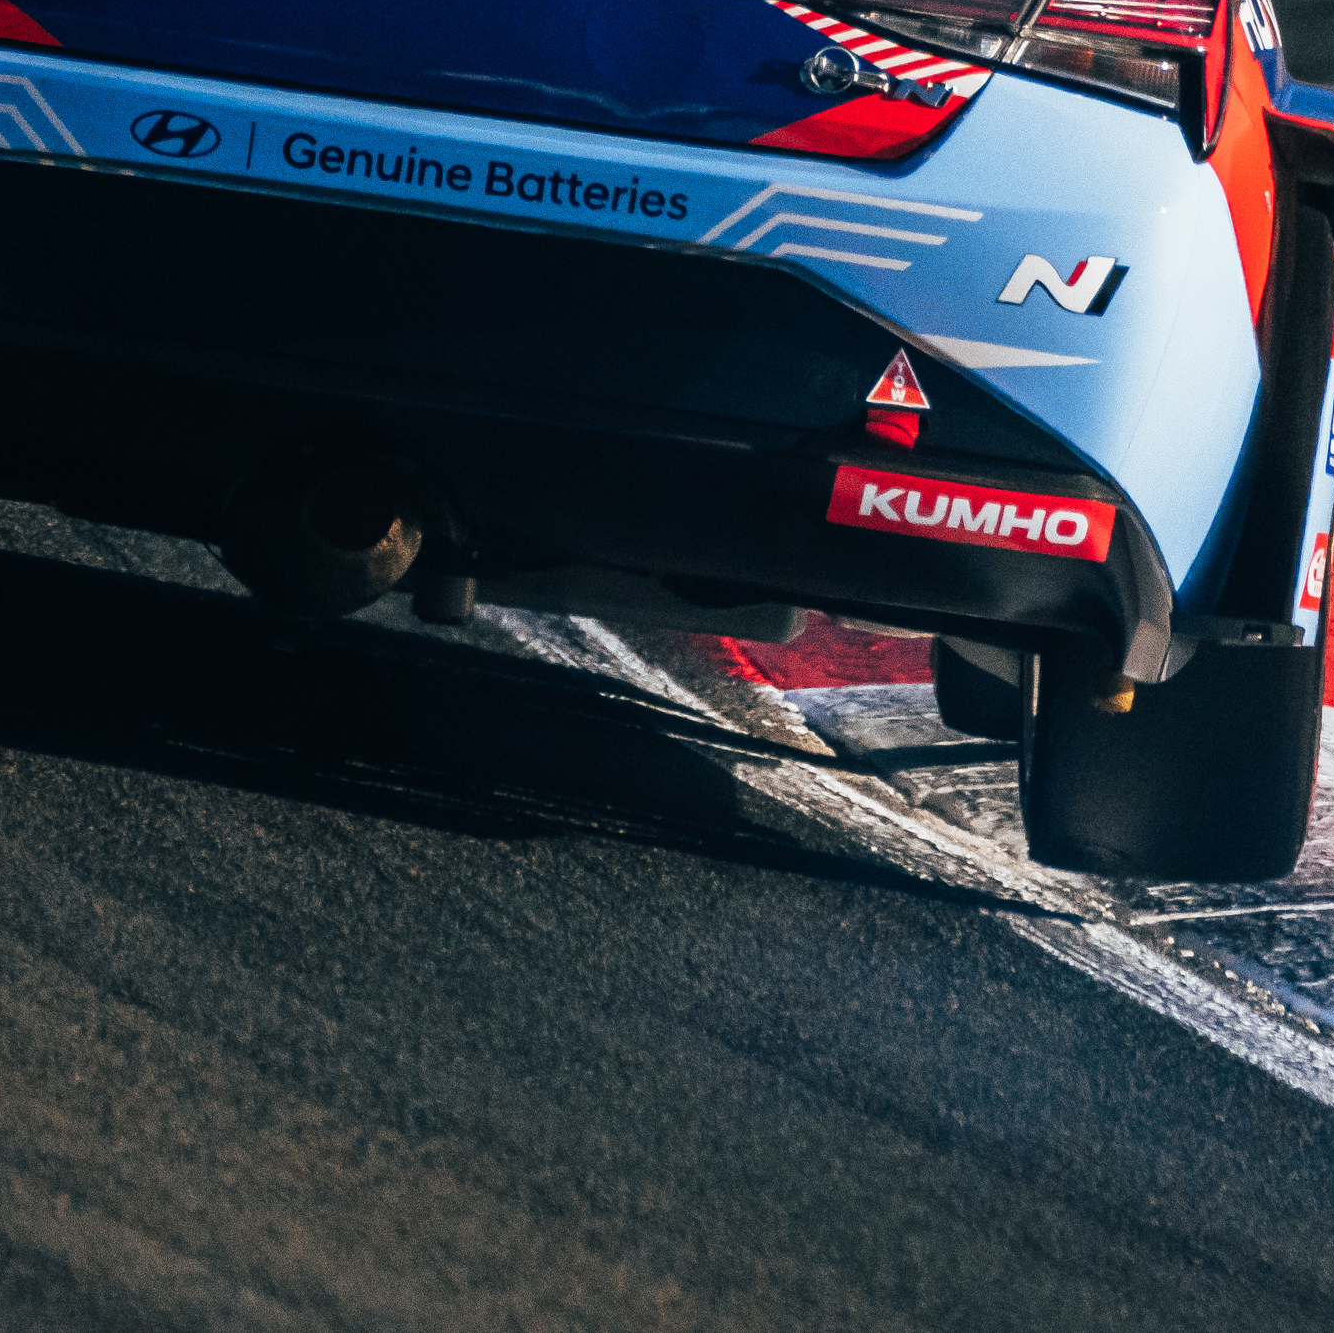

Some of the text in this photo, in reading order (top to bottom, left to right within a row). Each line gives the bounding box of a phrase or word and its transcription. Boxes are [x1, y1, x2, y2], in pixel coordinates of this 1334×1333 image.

[281, 132, 690, 221] Genuine Batteries
[858, 482, 1090, 548] KUMHO
